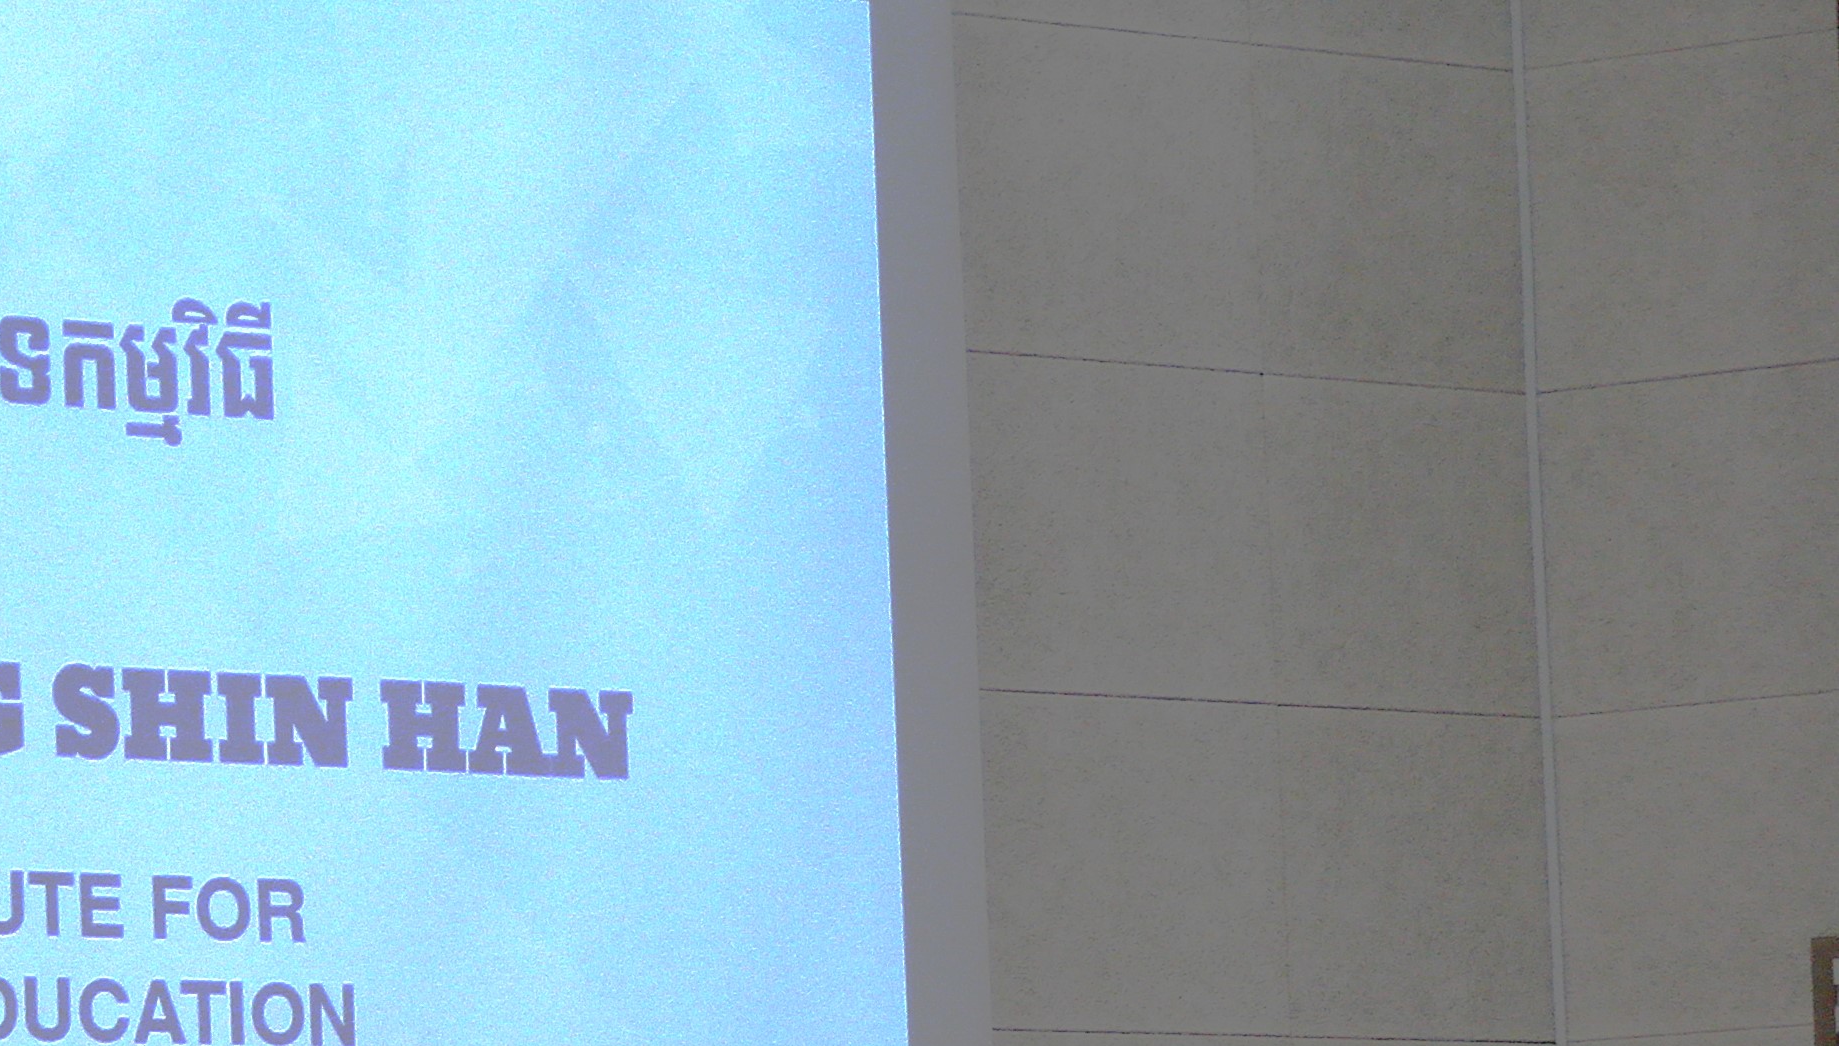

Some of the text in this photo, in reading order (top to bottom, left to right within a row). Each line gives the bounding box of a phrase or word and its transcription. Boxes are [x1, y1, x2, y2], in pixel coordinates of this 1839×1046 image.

[52, 663, 353, 768] SHIN
[379, 679, 634, 781] HAN
[151, 875, 307, 943] FOR
